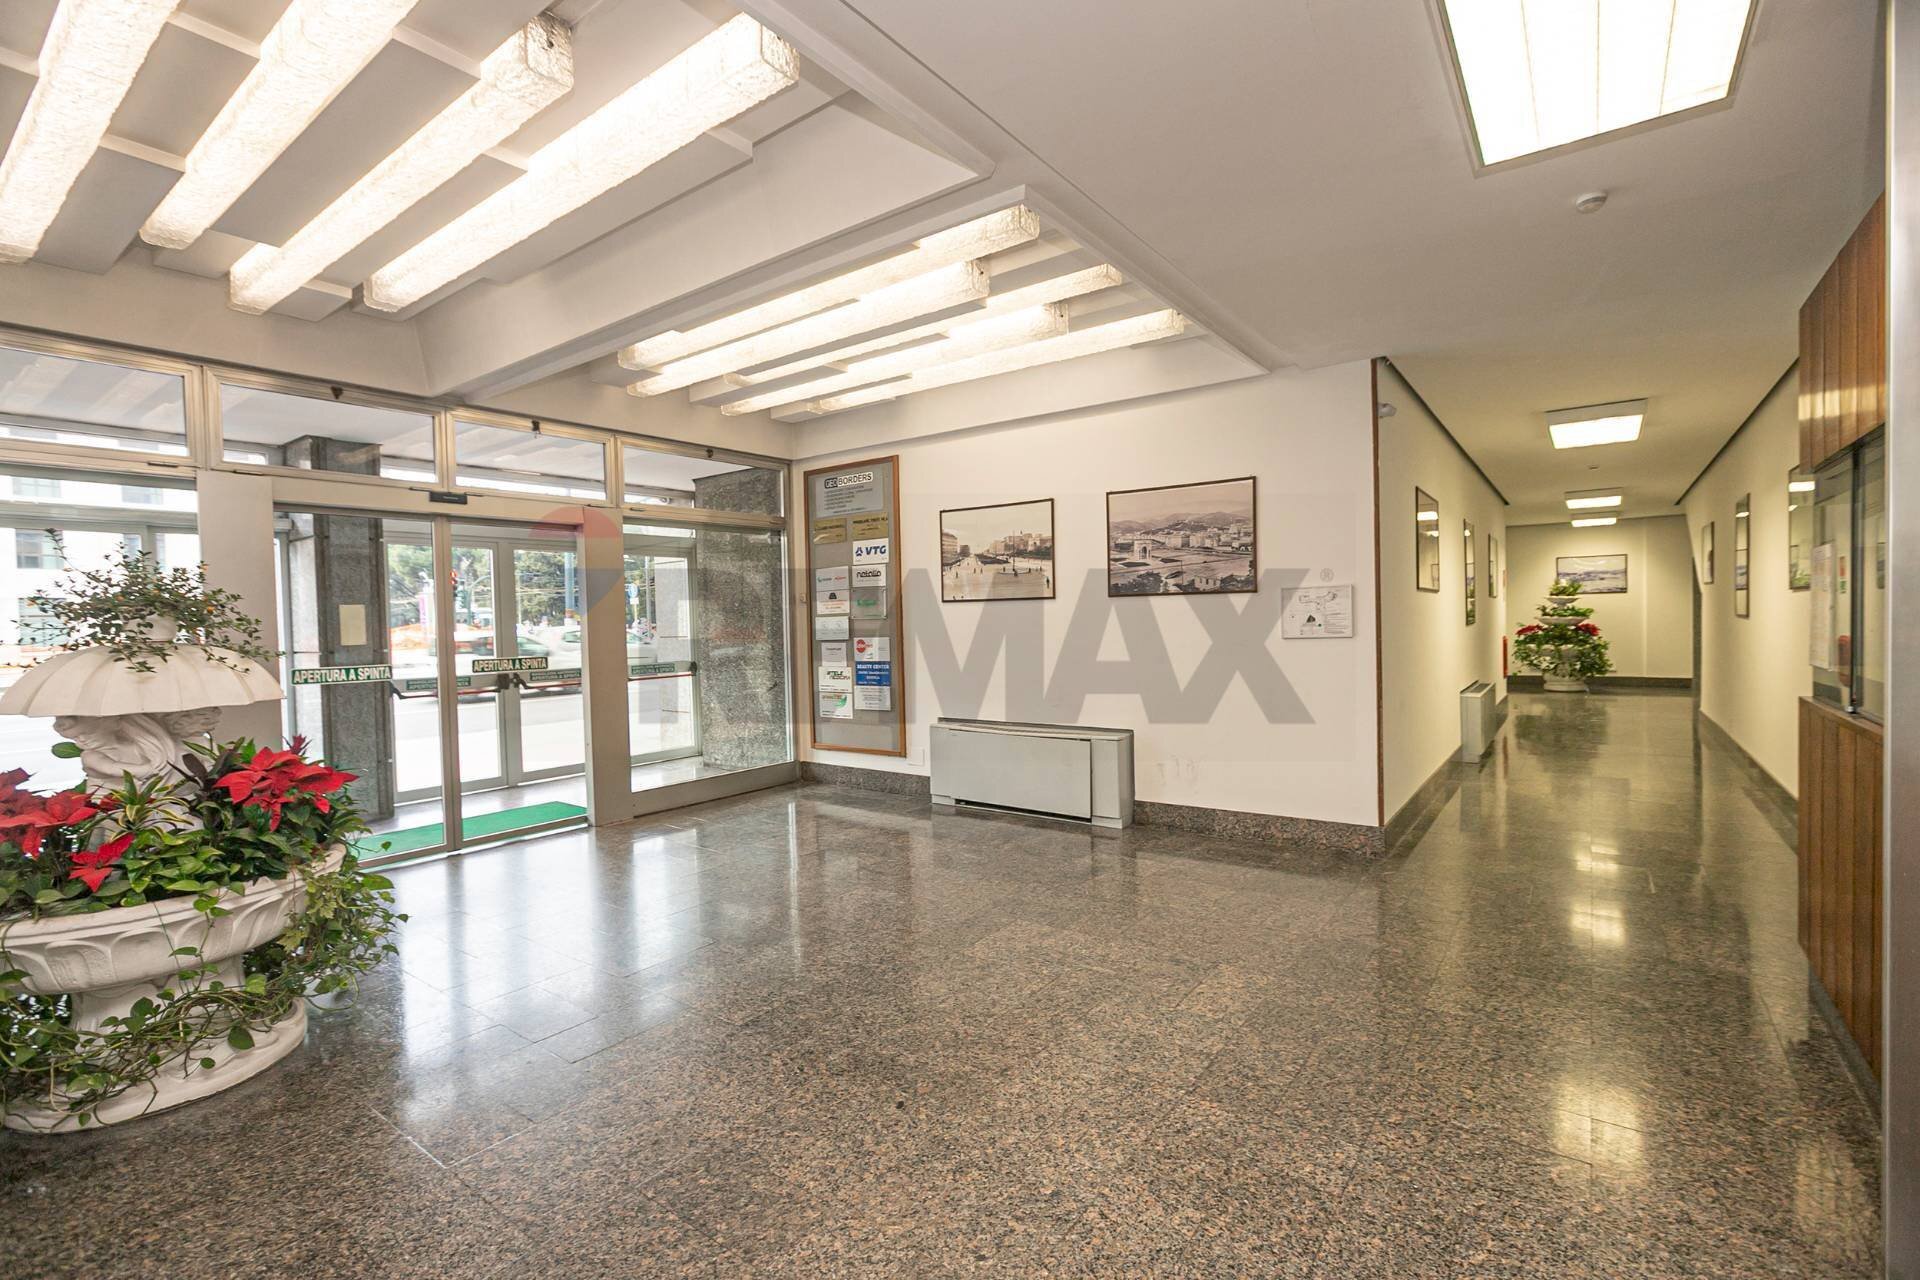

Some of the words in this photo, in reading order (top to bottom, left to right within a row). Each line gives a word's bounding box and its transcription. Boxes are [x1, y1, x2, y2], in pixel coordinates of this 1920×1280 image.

[865, 545, 887, 555] VTG
[474, 659, 513, 672] APERTURA
[514, 659, 522, 670] A
[522, 657, 547, 670] SPINTA
[294, 669, 347, 684] APERTURA
[348, 668, 357, 682] A
[358, 666, 392, 681] SPINTA
